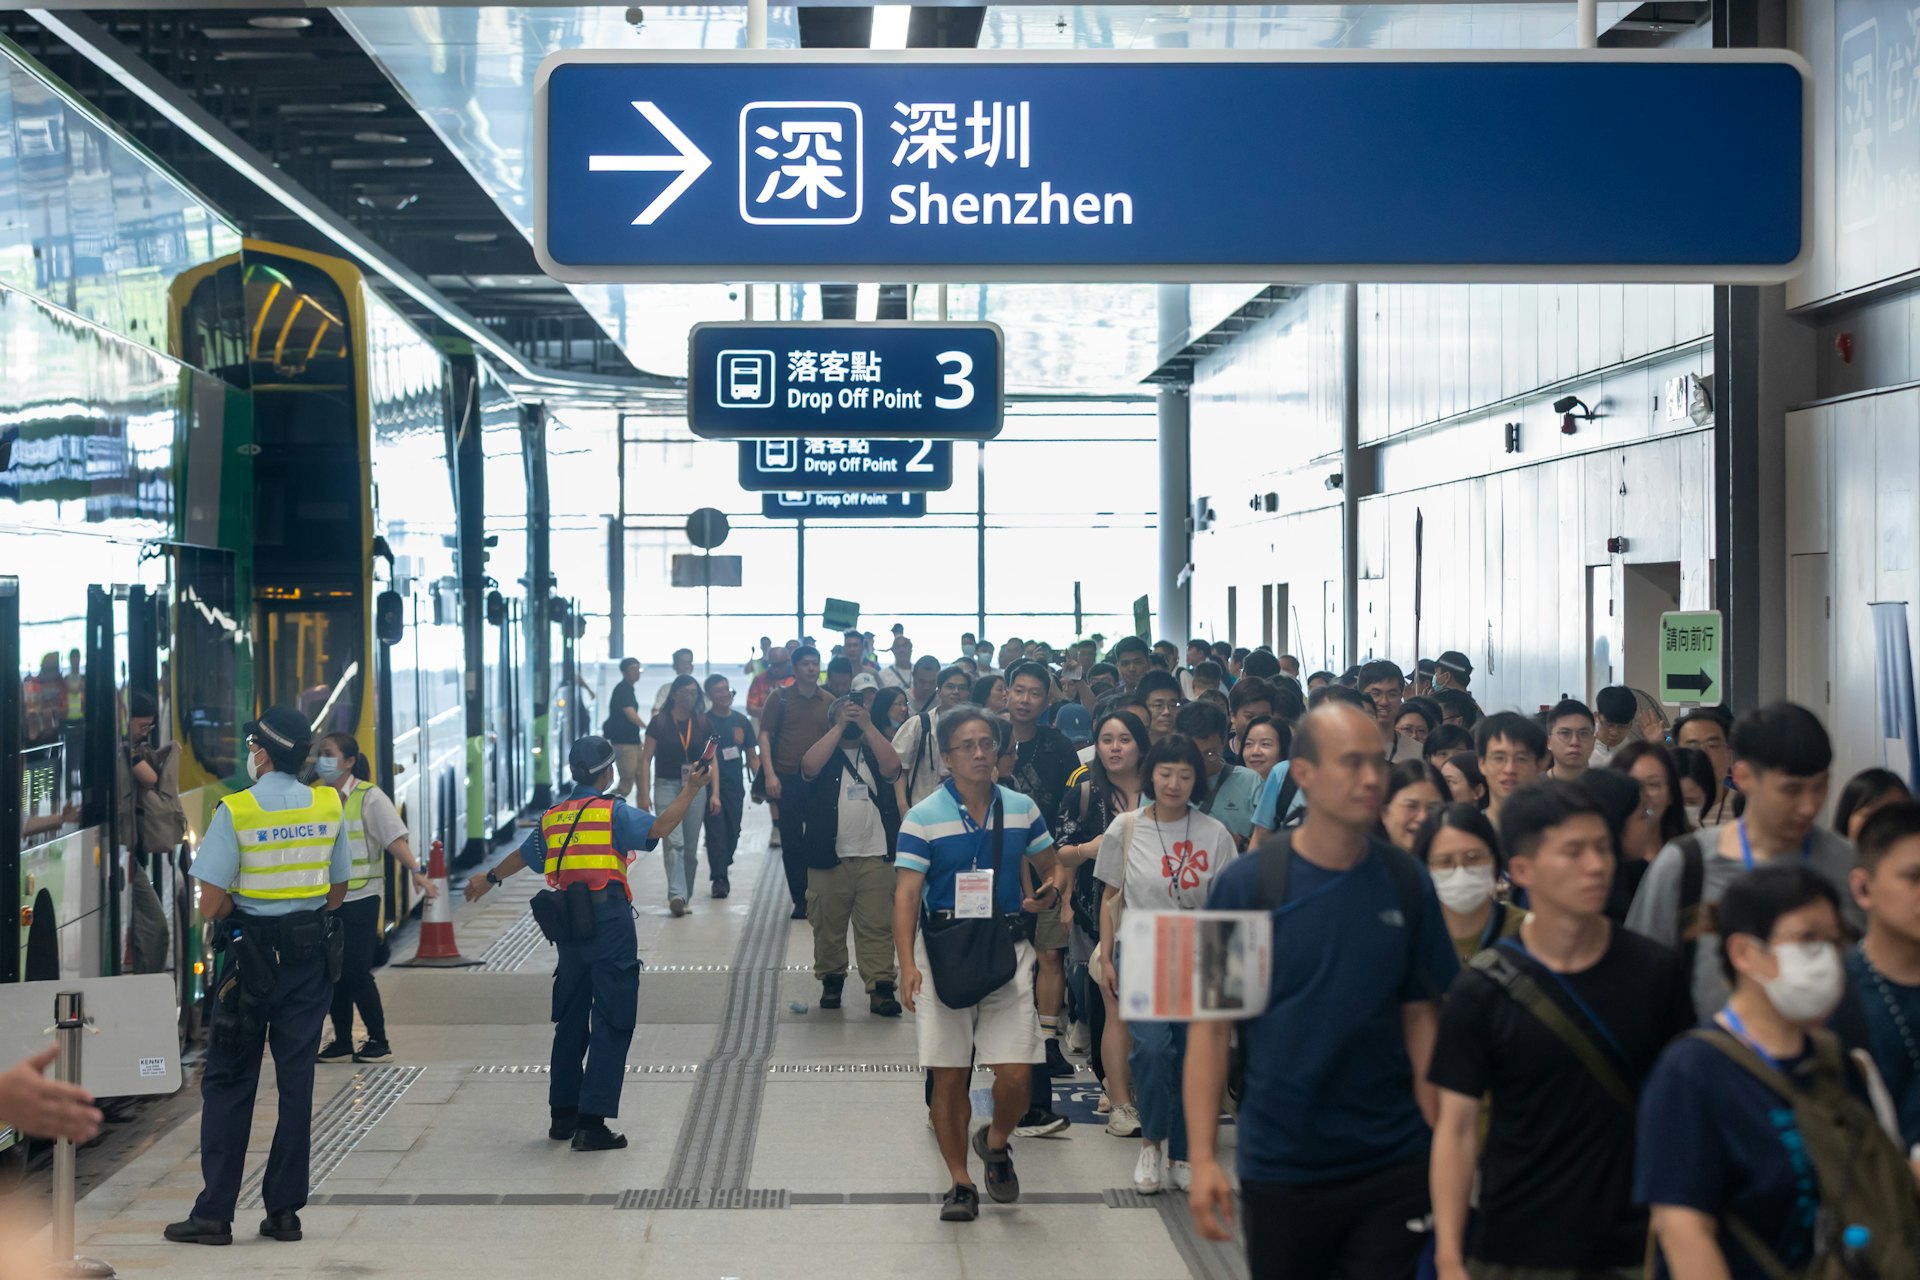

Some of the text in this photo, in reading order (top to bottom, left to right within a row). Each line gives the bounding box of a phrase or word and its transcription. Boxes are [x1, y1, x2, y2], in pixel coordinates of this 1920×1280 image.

[889, 100, 1030, 169] 深圳
[1845, 53, 1874, 199] 深
[754, 121, 847, 210] 深
[889, 181, 1133, 226] Shenzhen
[787, 350, 882, 383] 落客點
[935, 350, 975, 410] 3
[787, 387, 922, 414] Drop Off Point
[804, 456, 898, 476] Drop Off Point
[905, 440, 934, 472] 2
[815, 493, 840, 508] Drop
[842, 493, 860, 505] Off
[860, 493, 888, 506] Point
[1666, 626, 1714, 652] 請向前行
[272, 824, 314, 841] POLICE
